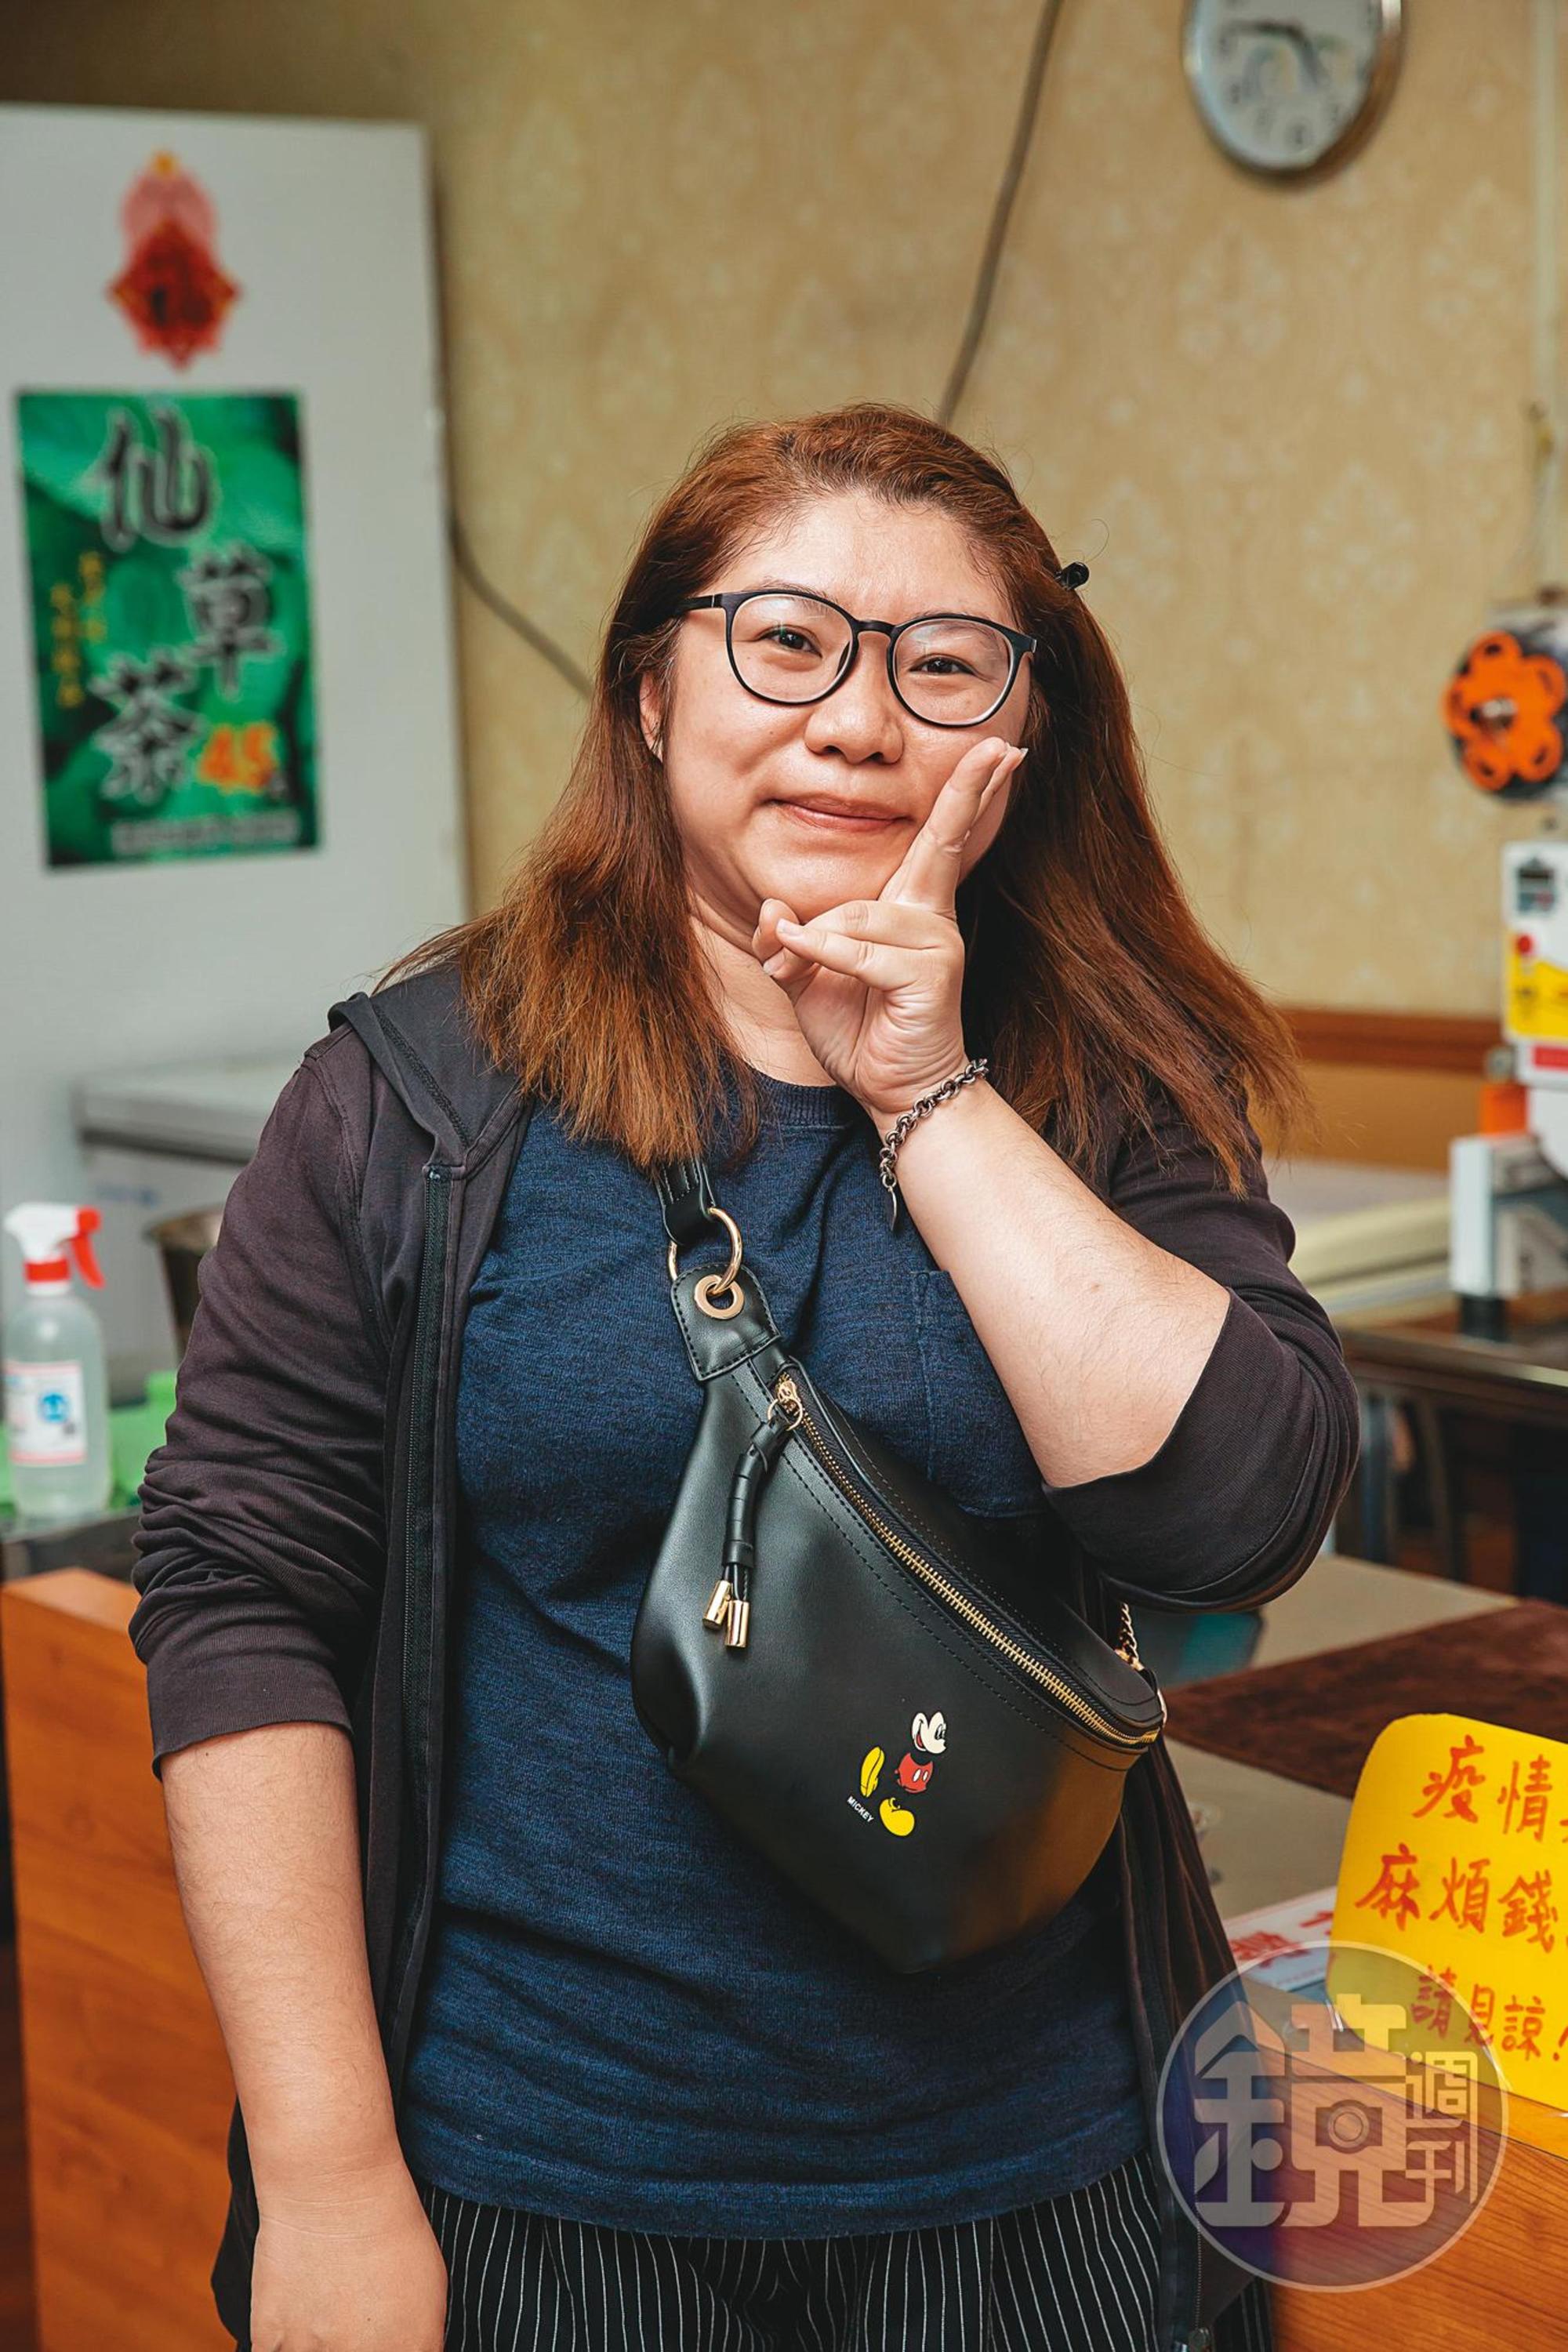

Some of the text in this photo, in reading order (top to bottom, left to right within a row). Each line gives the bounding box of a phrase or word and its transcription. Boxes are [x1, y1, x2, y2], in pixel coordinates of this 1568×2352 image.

[847, 1795, 874, 1823] MICKEY
[1412, 1734, 1568, 1842] 疫情
[1355, 1843, 1568, 1954] 麻煩錢
